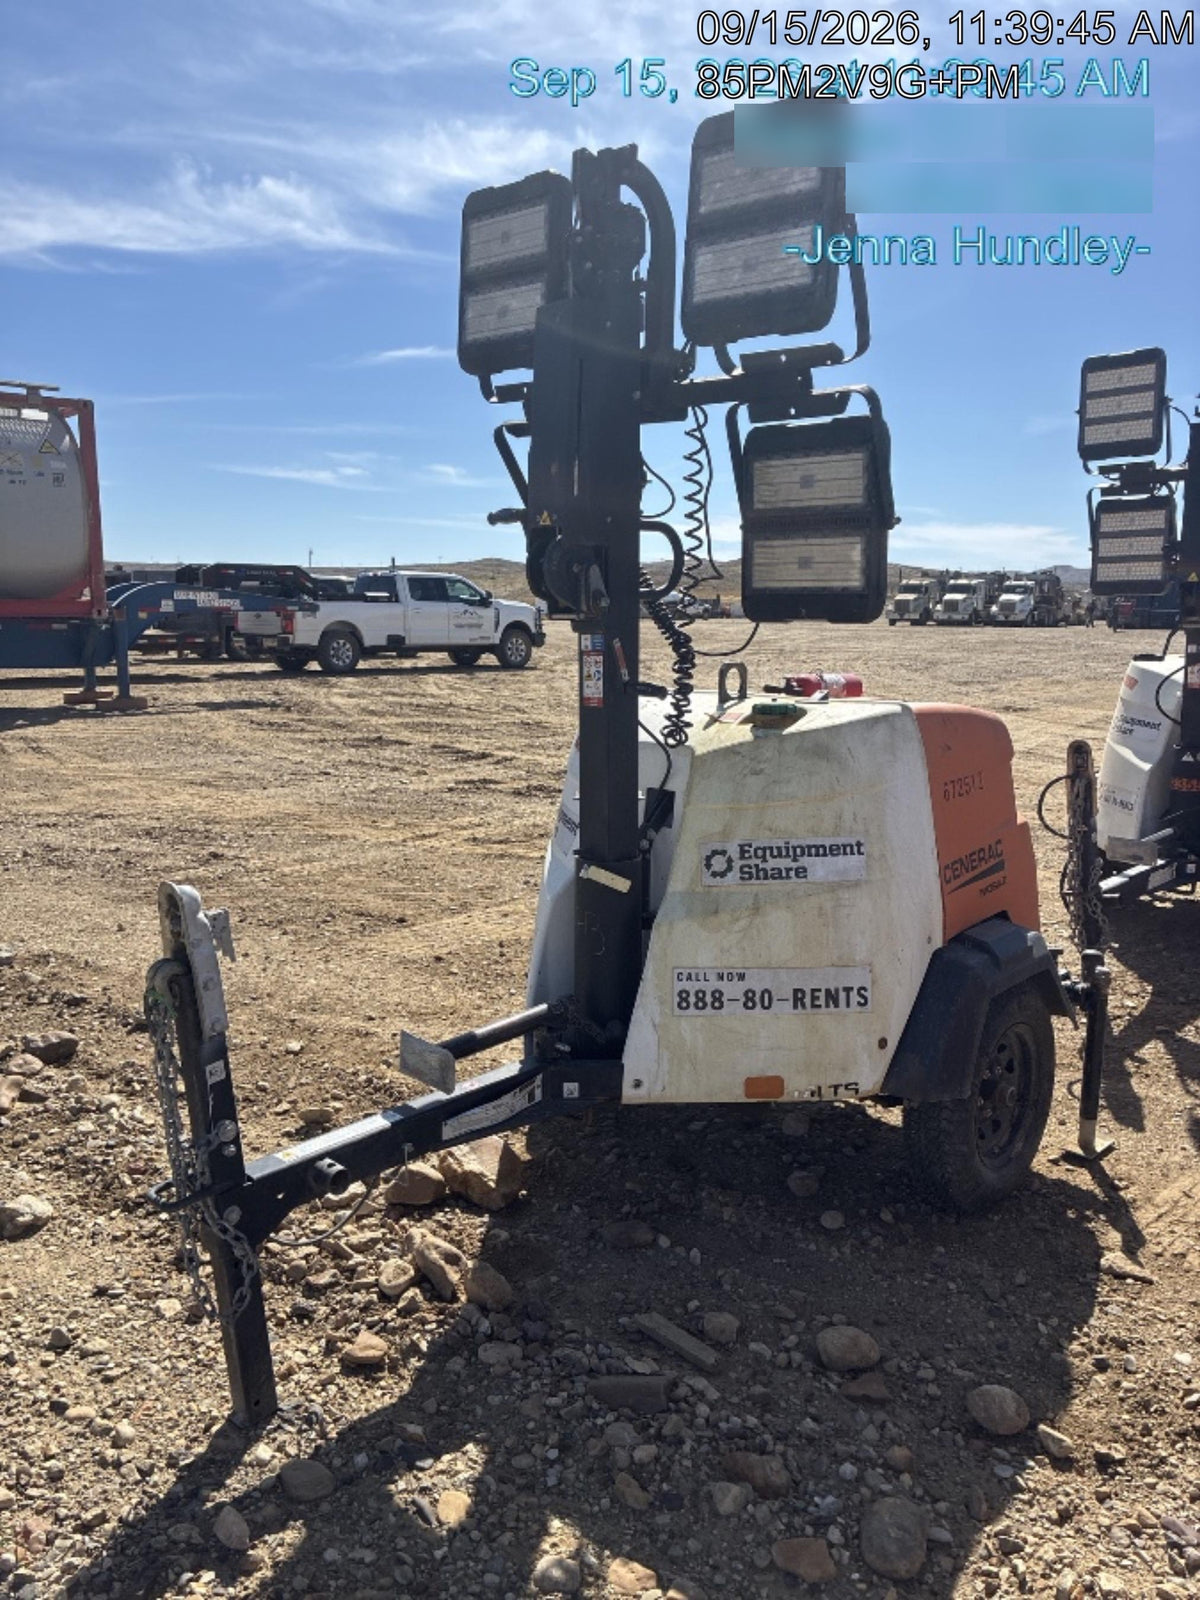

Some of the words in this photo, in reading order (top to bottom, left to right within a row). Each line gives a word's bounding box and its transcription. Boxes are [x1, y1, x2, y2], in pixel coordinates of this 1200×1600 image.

[737, 840, 865, 862] Equipment
[738, 864, 808, 881] Share
[677, 972, 710, 982] CALL
[716, 972, 747, 982] NOW
[676, 986, 869, 1011] 888-80-RENTS
